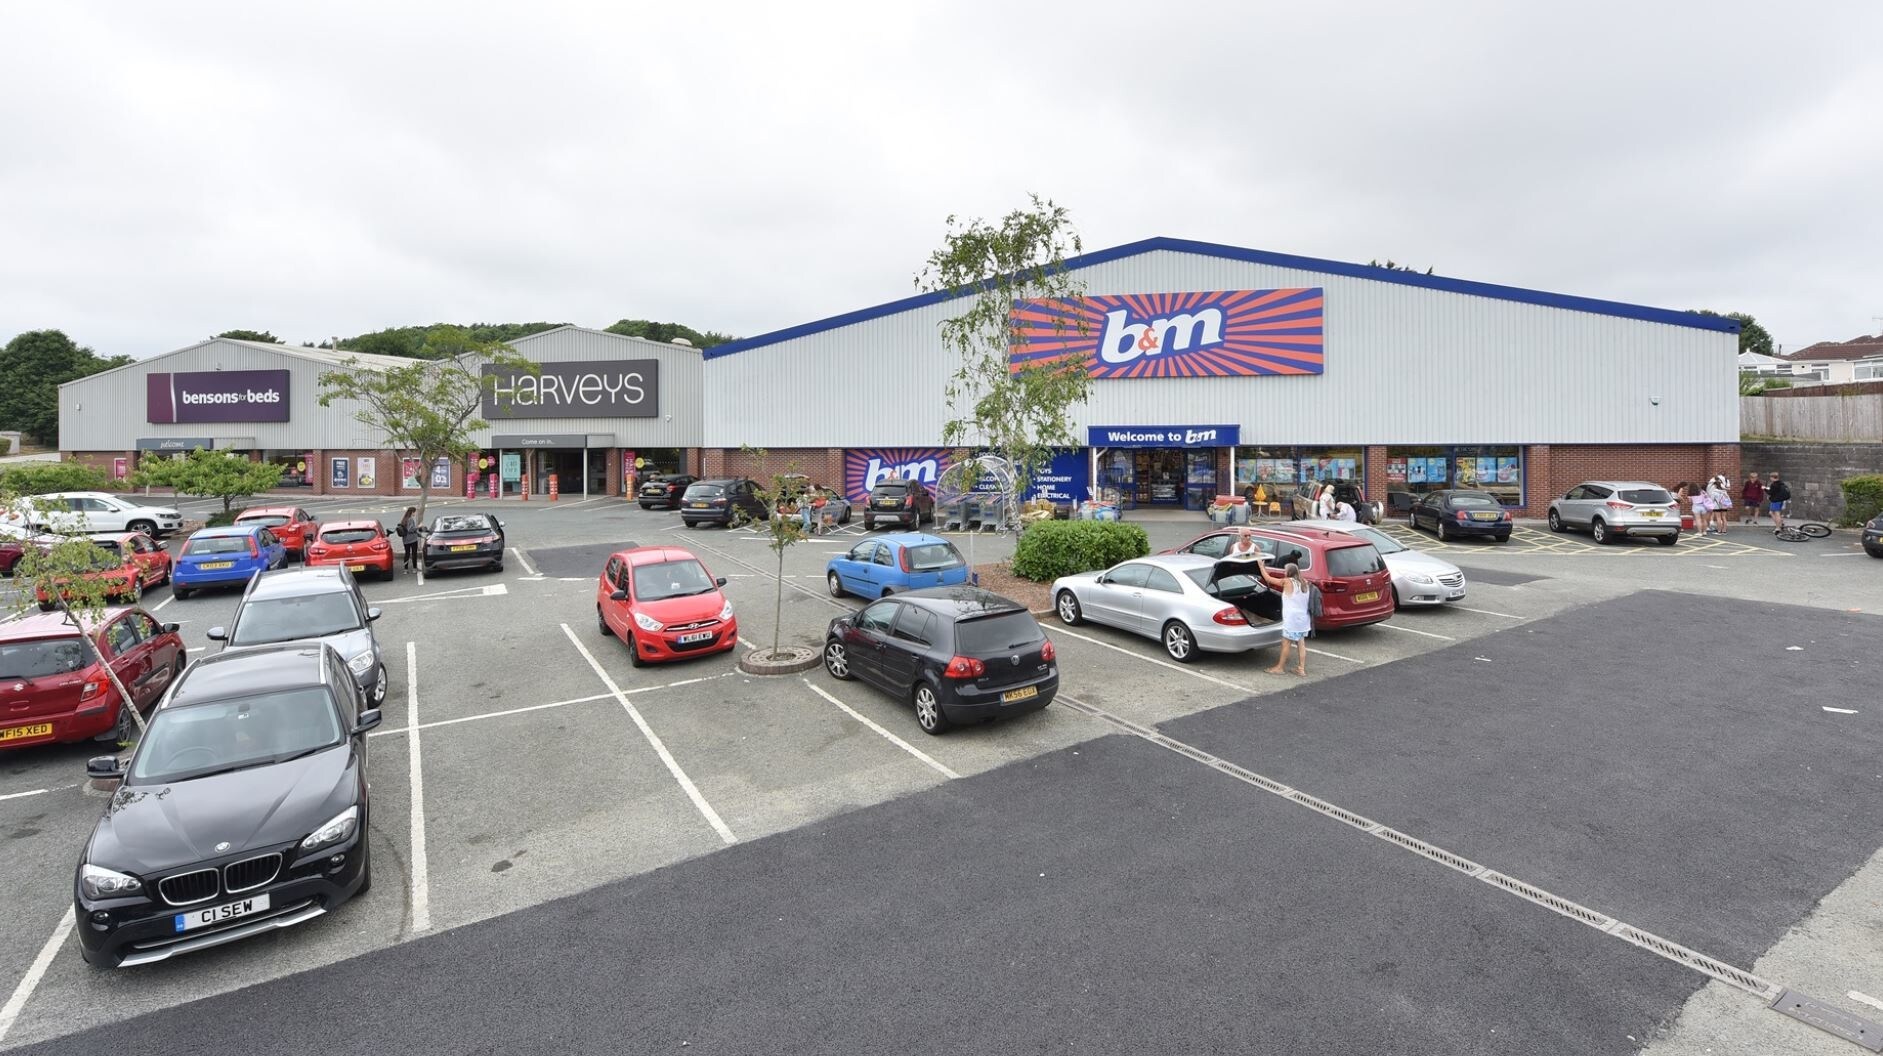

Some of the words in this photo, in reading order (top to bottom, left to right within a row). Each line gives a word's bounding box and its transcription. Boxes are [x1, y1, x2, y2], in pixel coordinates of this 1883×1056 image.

[1101, 308, 1223, 363] b&m
[182, 390, 238, 404] bensons
[238, 394, 247, 402] for
[247, 389, 280, 403] beds
[1108, 431, 1164, 442] Welcome
[1168, 432, 1182, 441] to
[26, 724, 48, 735] XED
[221, 900, 252, 917] SEW
